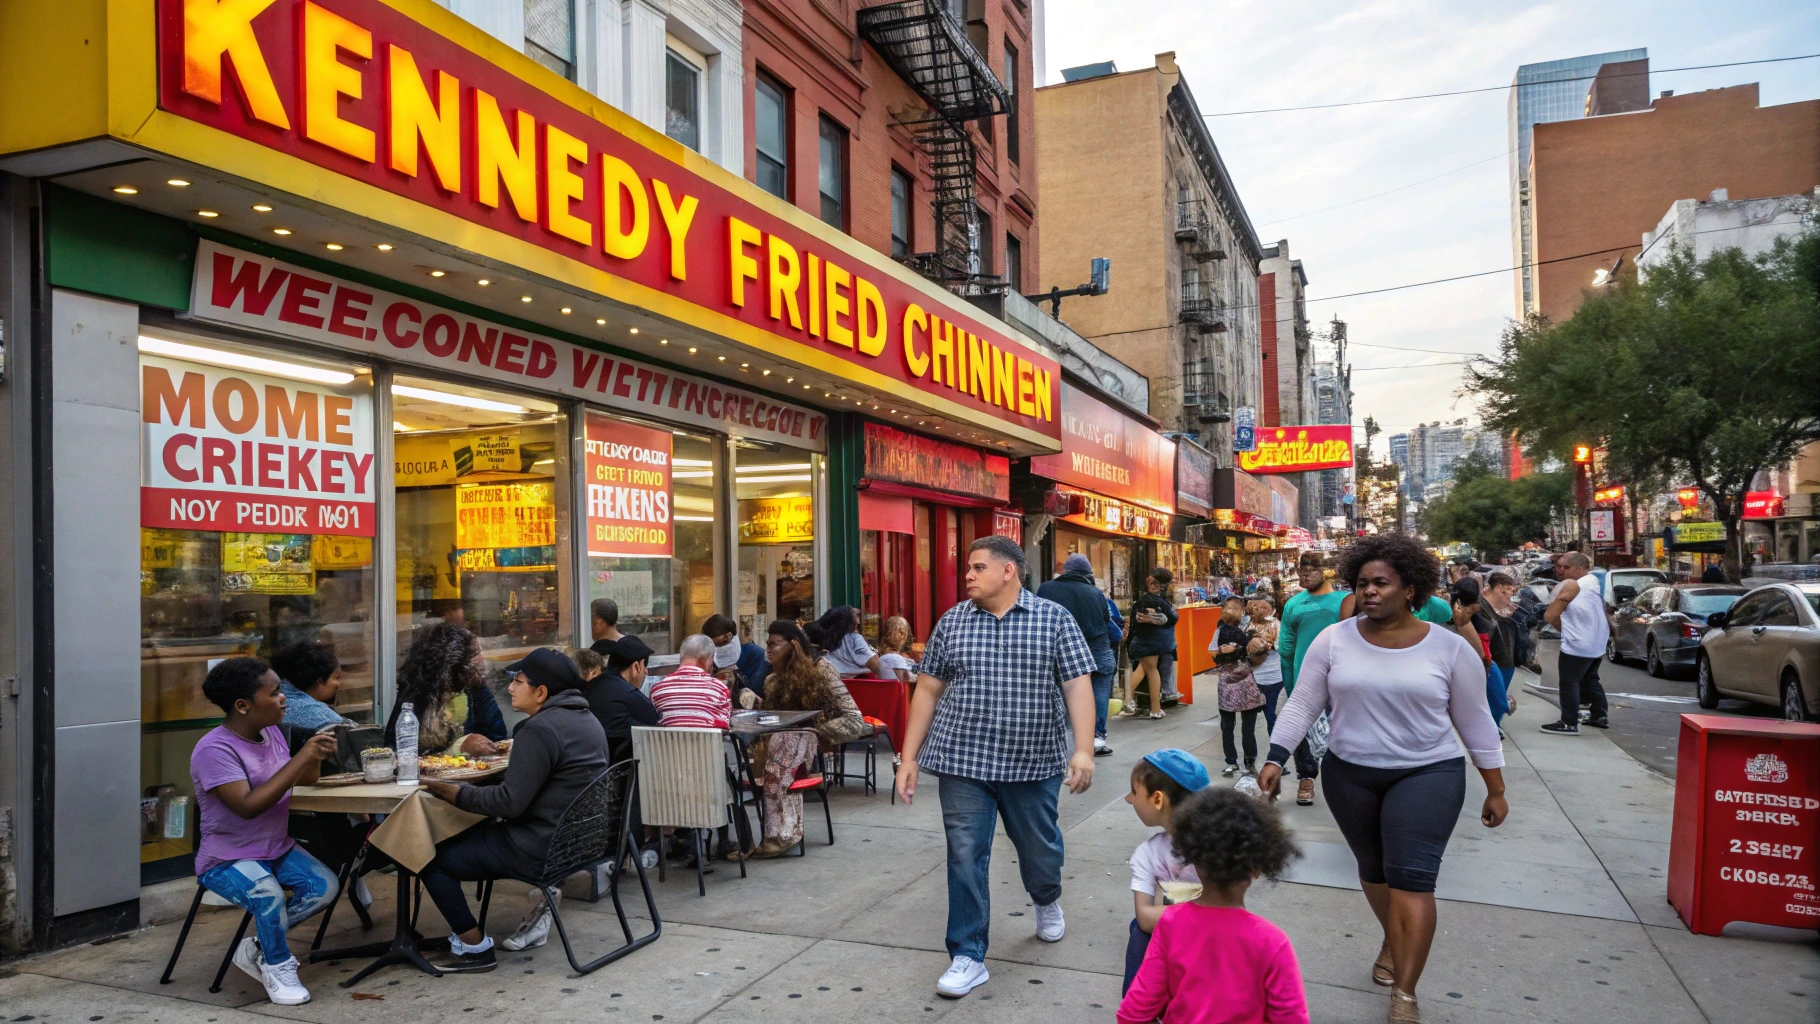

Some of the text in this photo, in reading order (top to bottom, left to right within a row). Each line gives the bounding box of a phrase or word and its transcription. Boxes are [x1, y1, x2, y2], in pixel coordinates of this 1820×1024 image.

[179, 0, 1053, 423] KENNEDY FRIED CHINNEN
[142, 364, 354, 447] MOME
[162, 433, 374, 494] CRIEKEY
[170, 498, 222, 522] NOY
